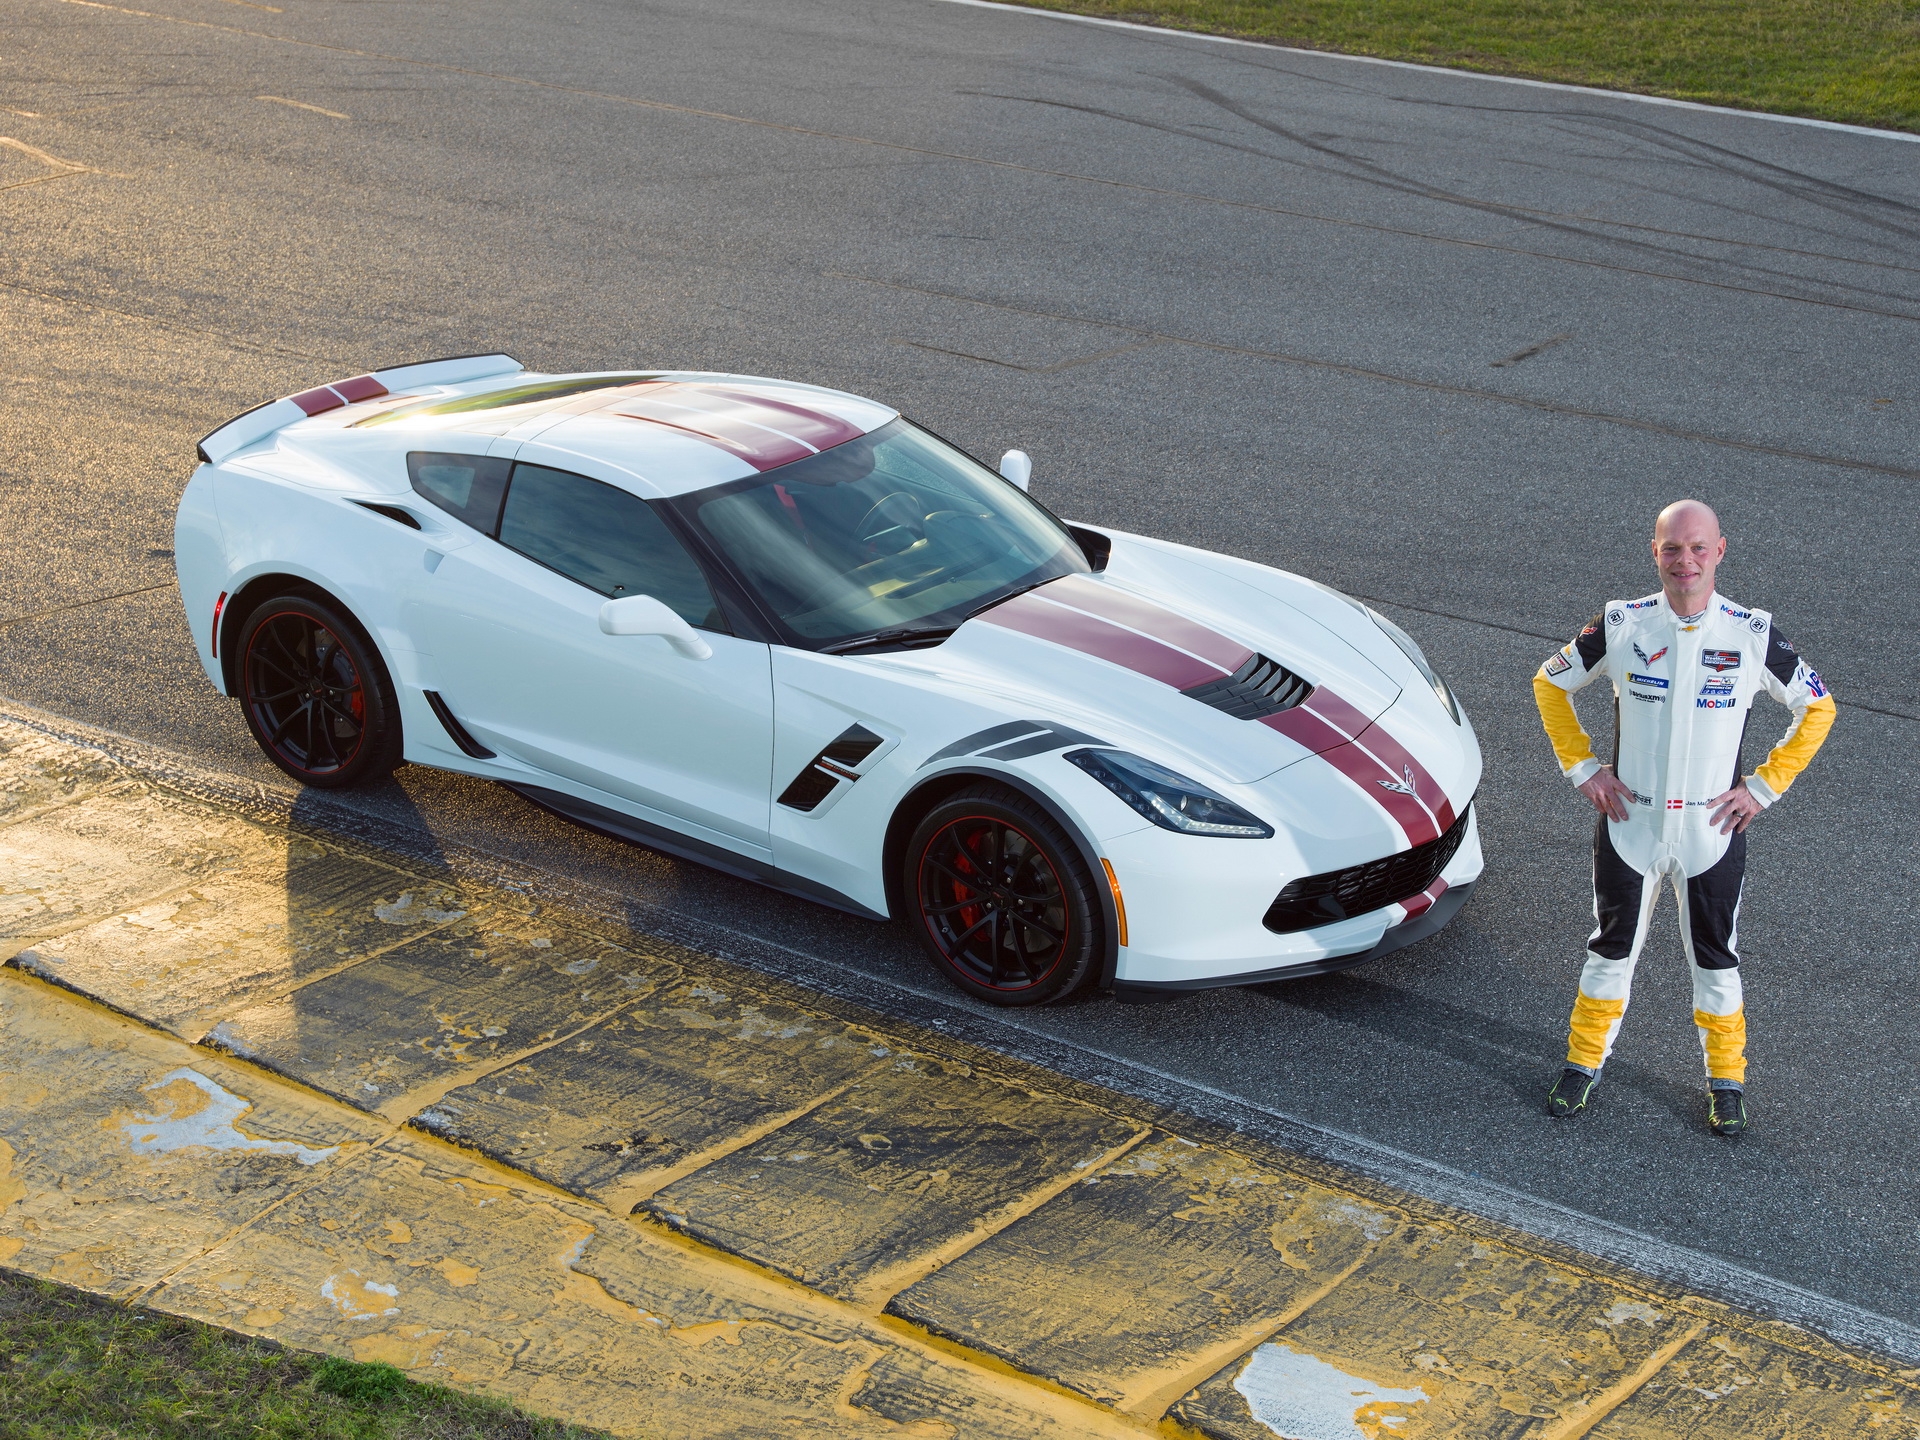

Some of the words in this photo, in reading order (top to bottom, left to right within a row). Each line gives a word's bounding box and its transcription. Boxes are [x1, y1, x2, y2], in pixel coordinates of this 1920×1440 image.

[1610, 612, 1621, 622] 21
[1753, 621, 1764, 630] 21
[1636, 677, 1665, 686] MICHELIN
[1696, 698, 1727, 709] Mobil
